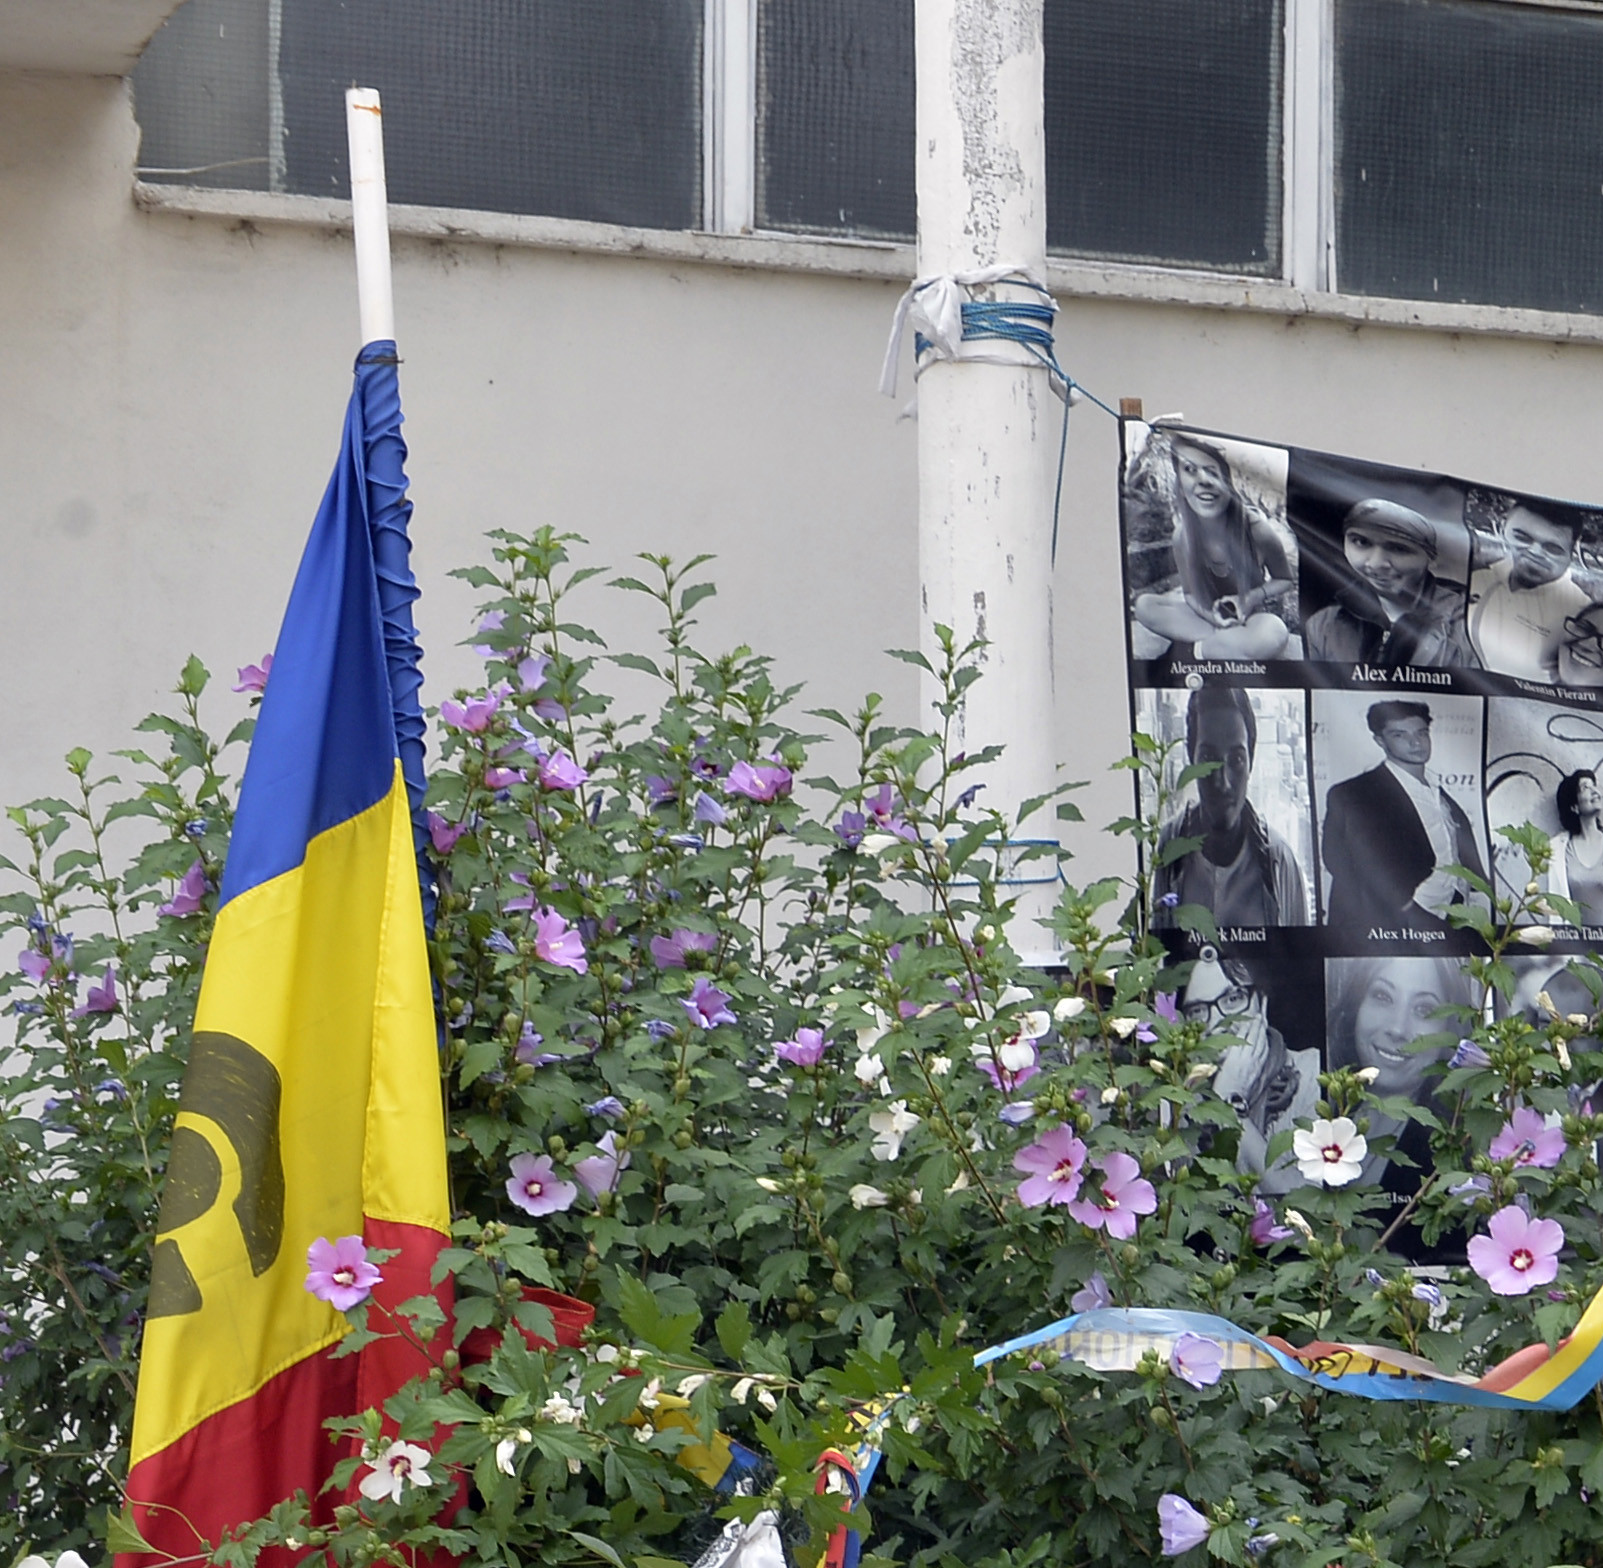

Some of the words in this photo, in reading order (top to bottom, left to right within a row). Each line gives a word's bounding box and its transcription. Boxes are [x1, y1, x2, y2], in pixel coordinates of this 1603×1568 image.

[1170, 661, 1222, 674] Alexandra
[1224, 661, 1266, 675] Matache
[1351, 664, 1387, 682] Alex
[1391, 666, 1451, 685] Aliman
[1514, 679, 1555, 698] Valentin
[1556, 686, 1596, 701] Fieraru
[1229, 929, 1267, 942] Manci
[1367, 927, 1399, 940] Alex
[1402, 927, 1446, 942] Hogea
[1549, 927, 1579, 941] onica
